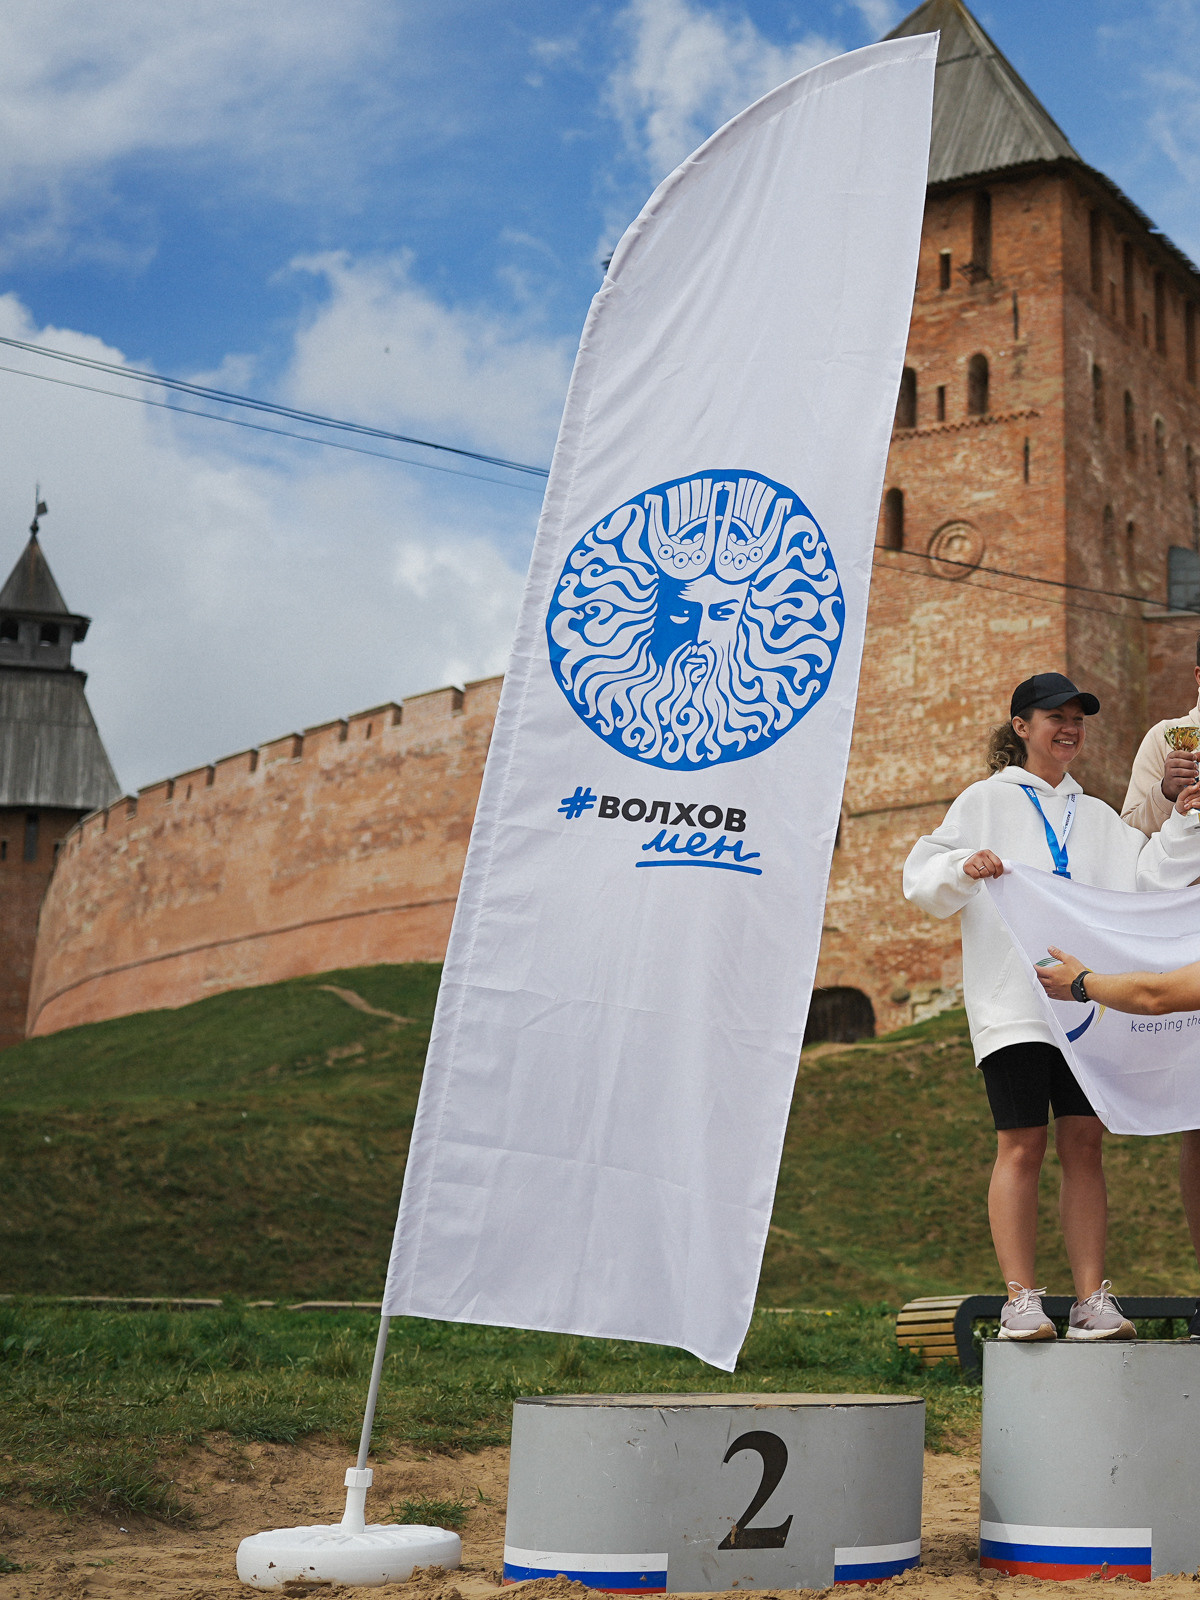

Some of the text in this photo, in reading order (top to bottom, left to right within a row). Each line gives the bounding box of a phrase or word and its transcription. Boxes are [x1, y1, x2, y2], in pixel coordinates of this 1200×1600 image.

[641, 829, 761, 862] мен
[1131, 1018, 1183, 1034] keeping
[717, 1430, 794, 1550] 2
